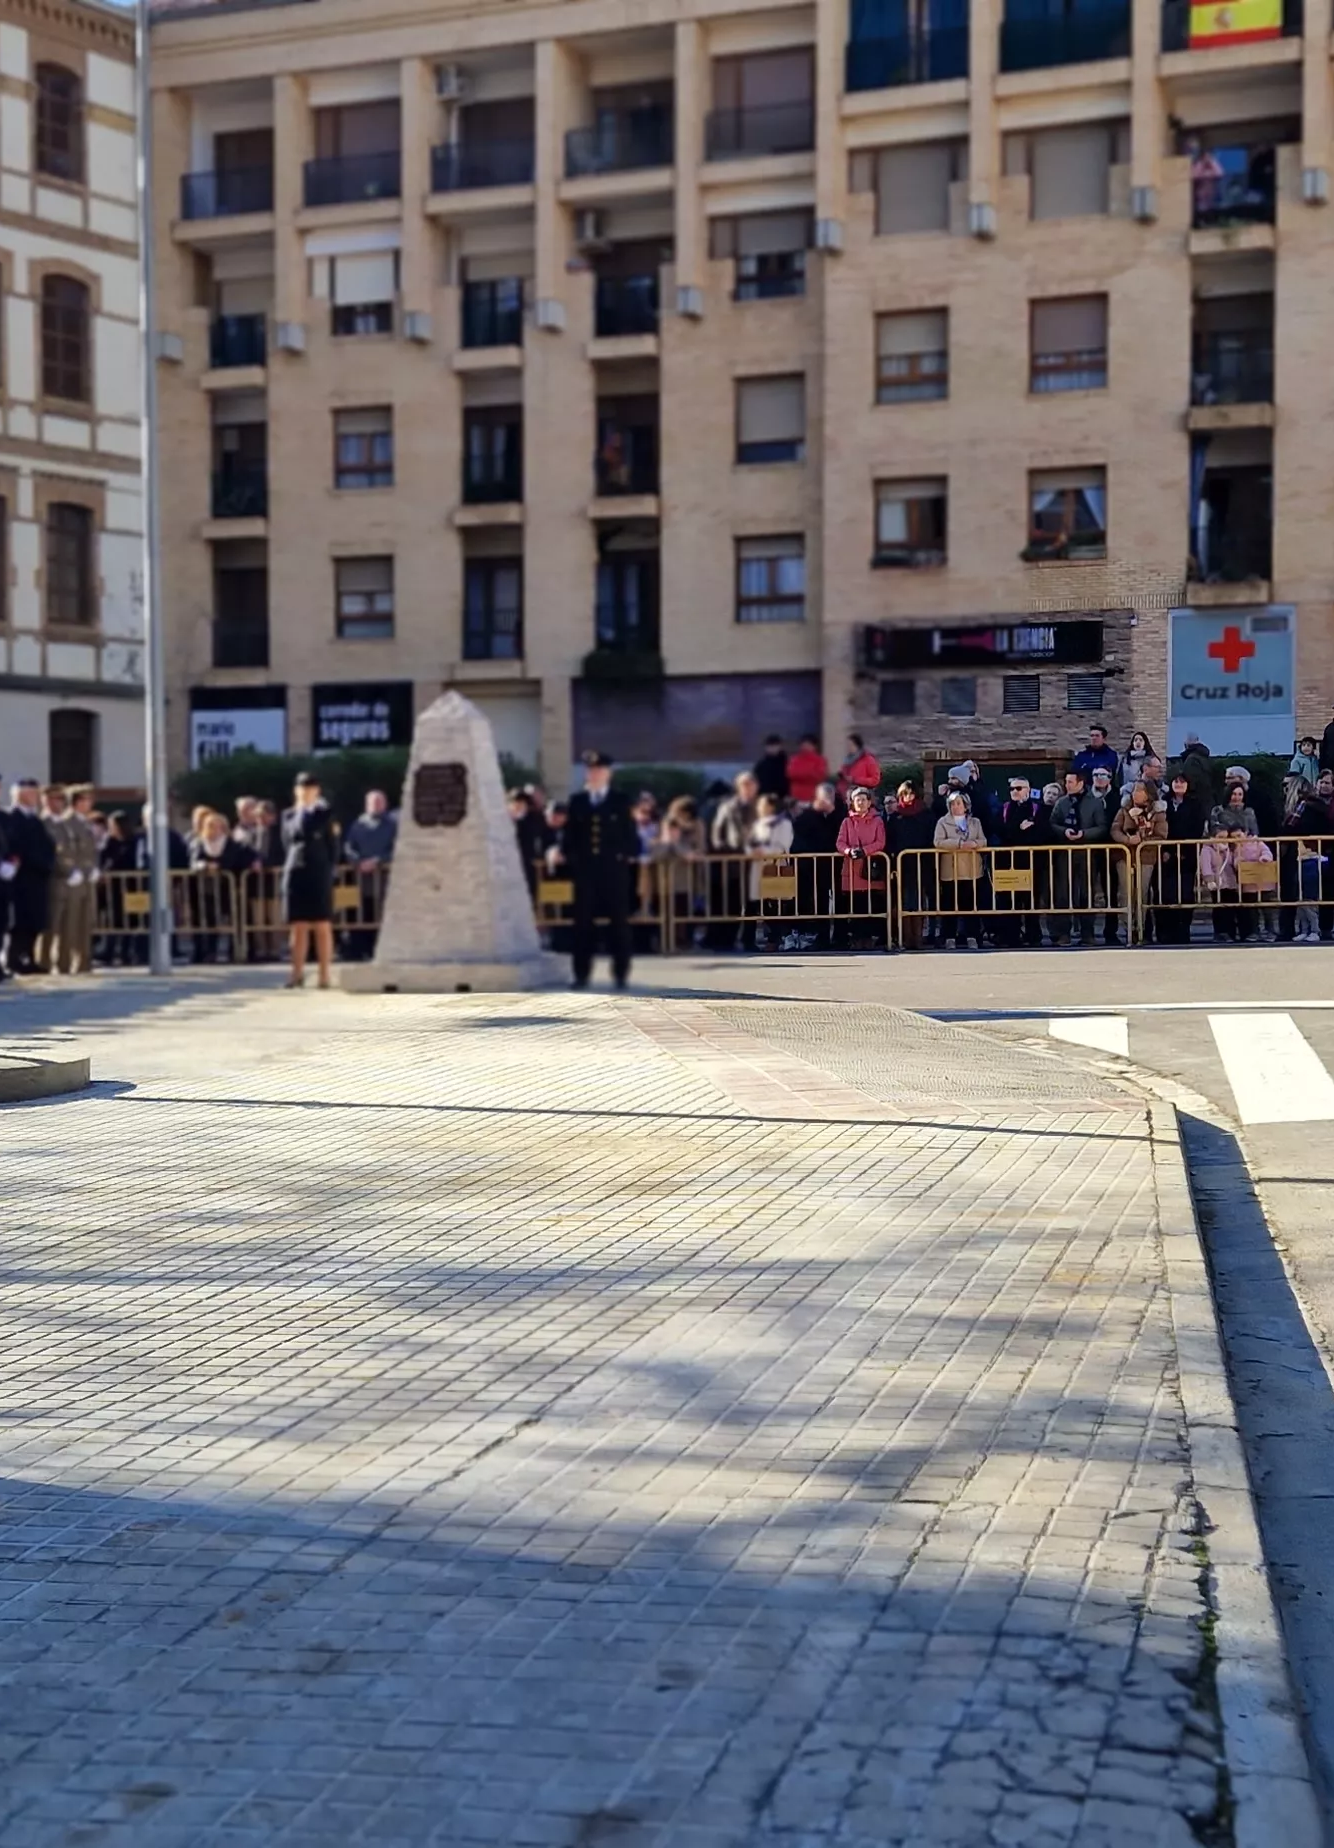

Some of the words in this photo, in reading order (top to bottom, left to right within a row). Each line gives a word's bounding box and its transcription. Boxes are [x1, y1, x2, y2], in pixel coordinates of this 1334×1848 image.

[1180, 684, 1229, 700] Cruz
[1236, 680, 1284, 701] Roja
[374, 702, 389, 717] de
[320, 721, 390, 745] seguros
